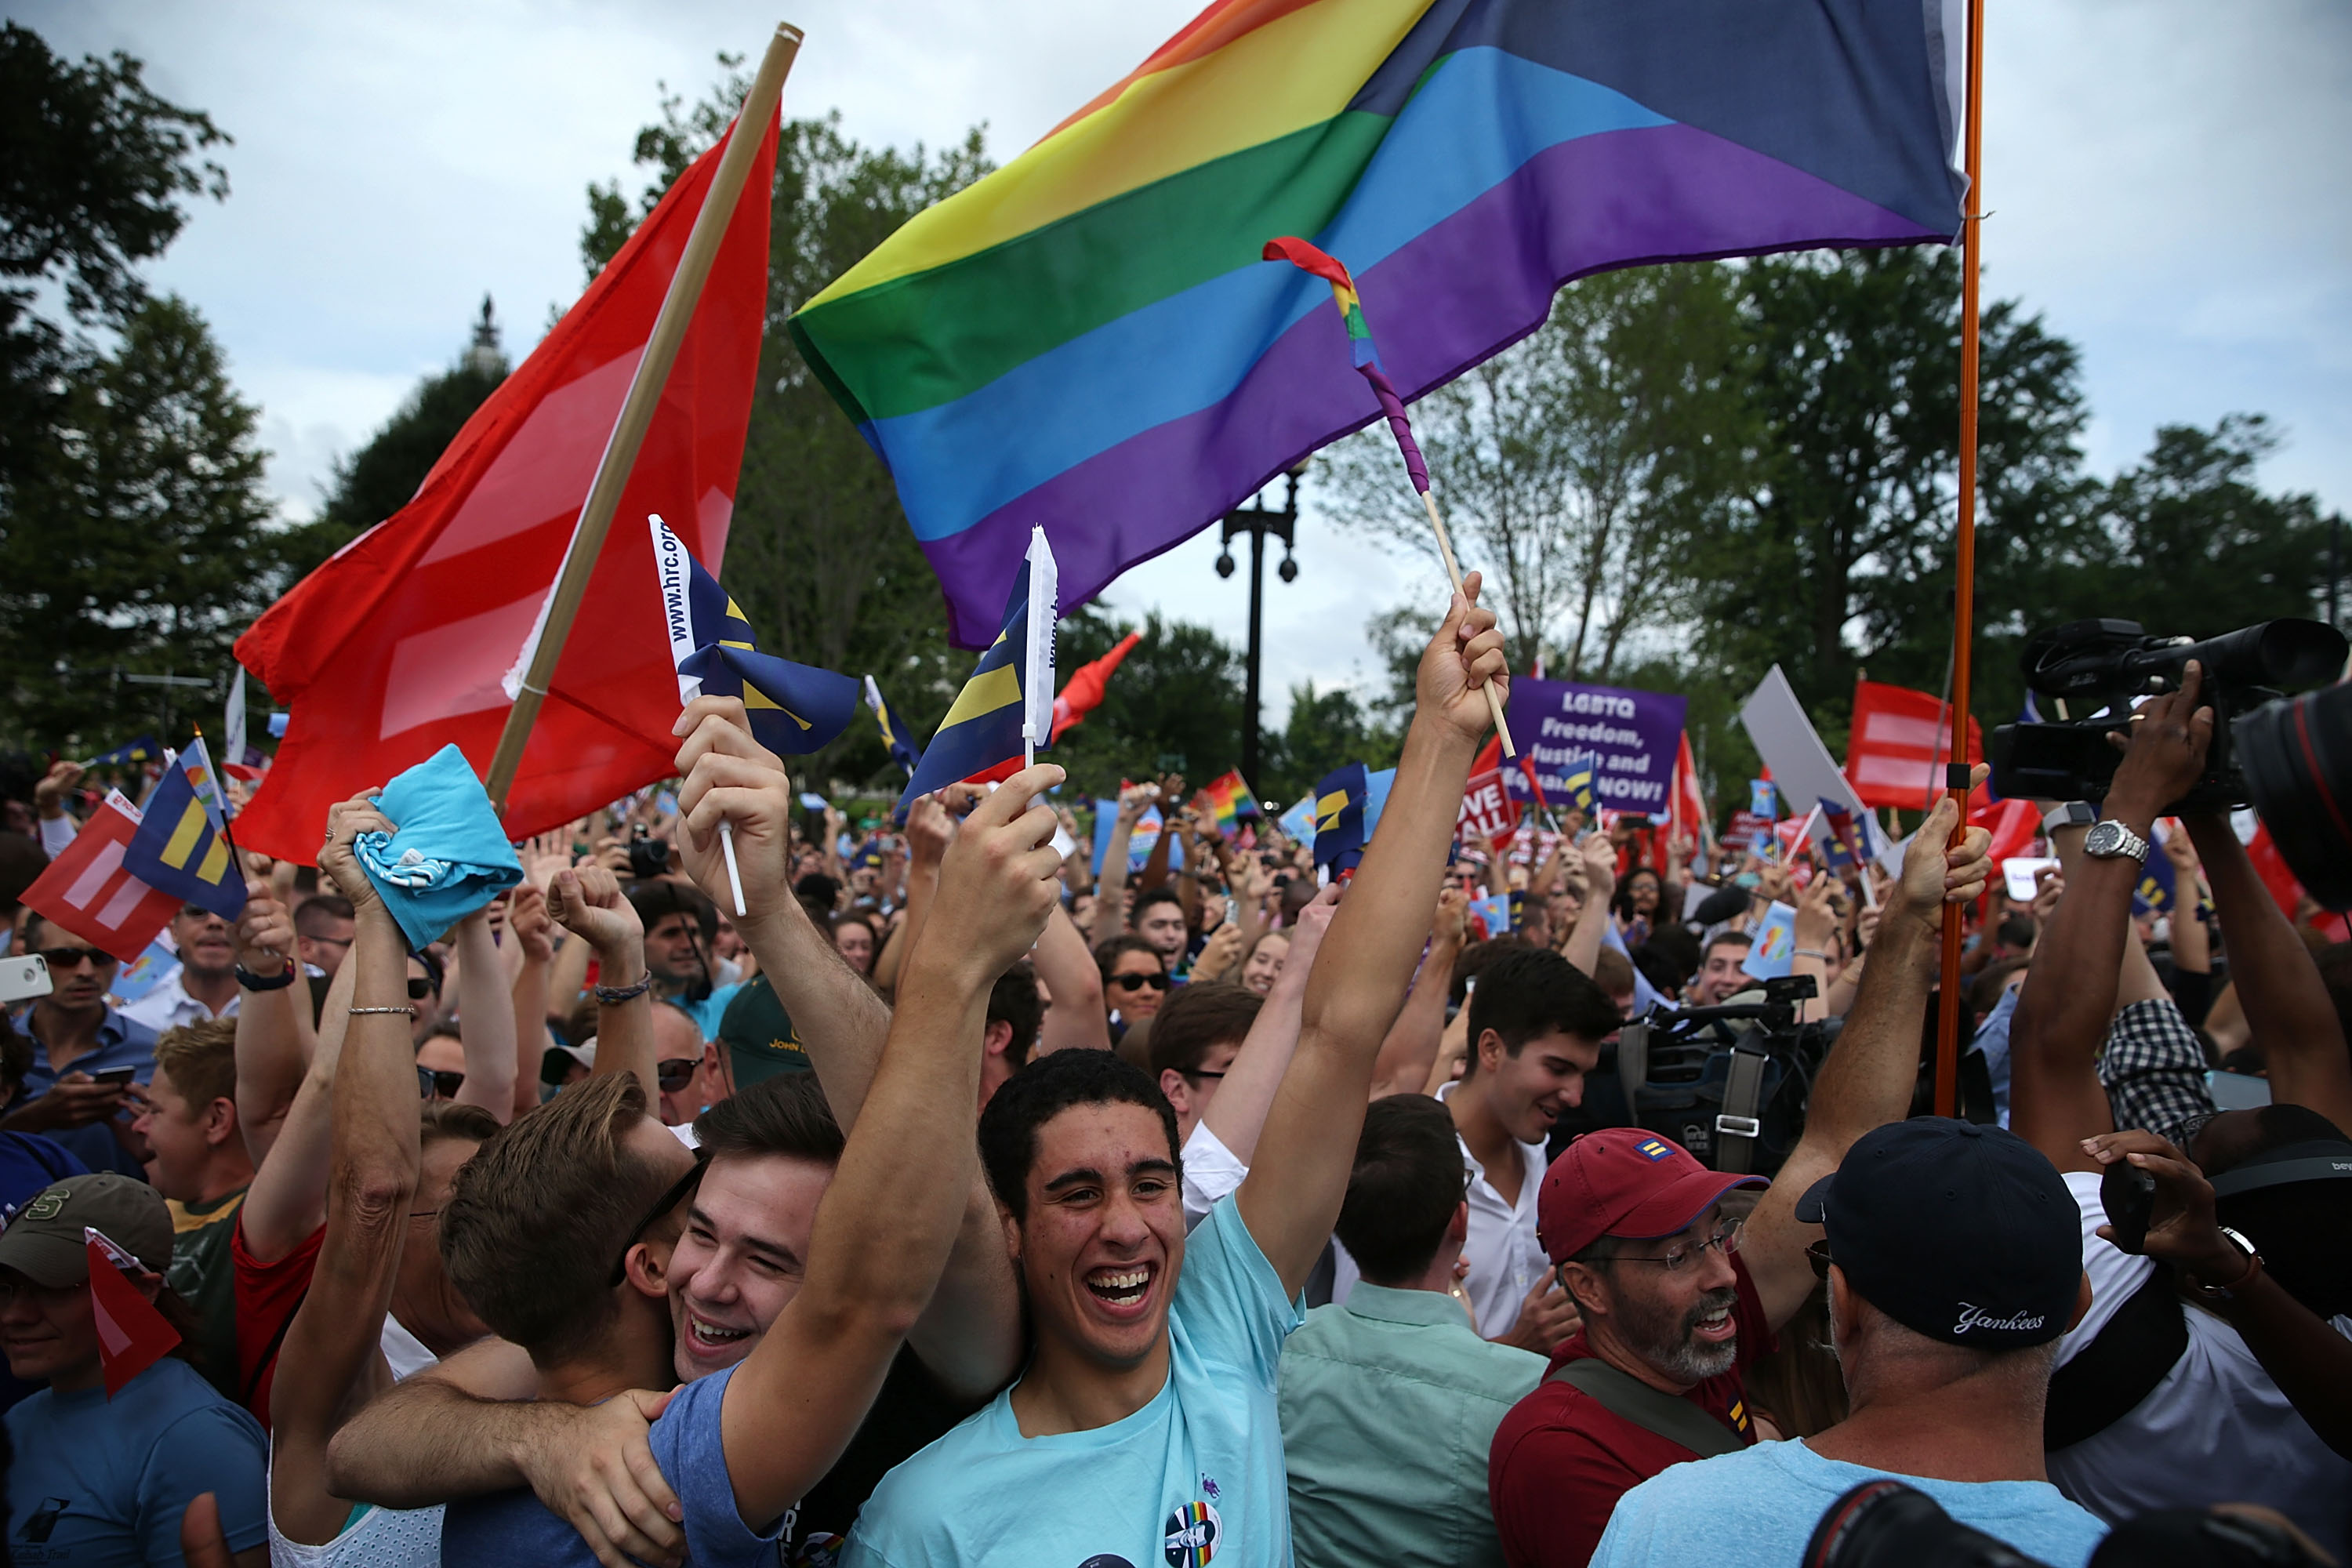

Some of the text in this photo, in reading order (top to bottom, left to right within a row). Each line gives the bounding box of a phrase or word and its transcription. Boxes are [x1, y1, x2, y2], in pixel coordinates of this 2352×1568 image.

[1562, 691, 1636, 719] LGBTQ
[1541, 717, 1645, 749] Freedom,
[1607, 752, 1651, 773] and
[1597, 776, 1663, 802] NOW!
[768, 1038, 800, 1051] JOHN
[25, 1189, 71, 1220] S
[1953, 1301, 2045, 1334] Yankees
